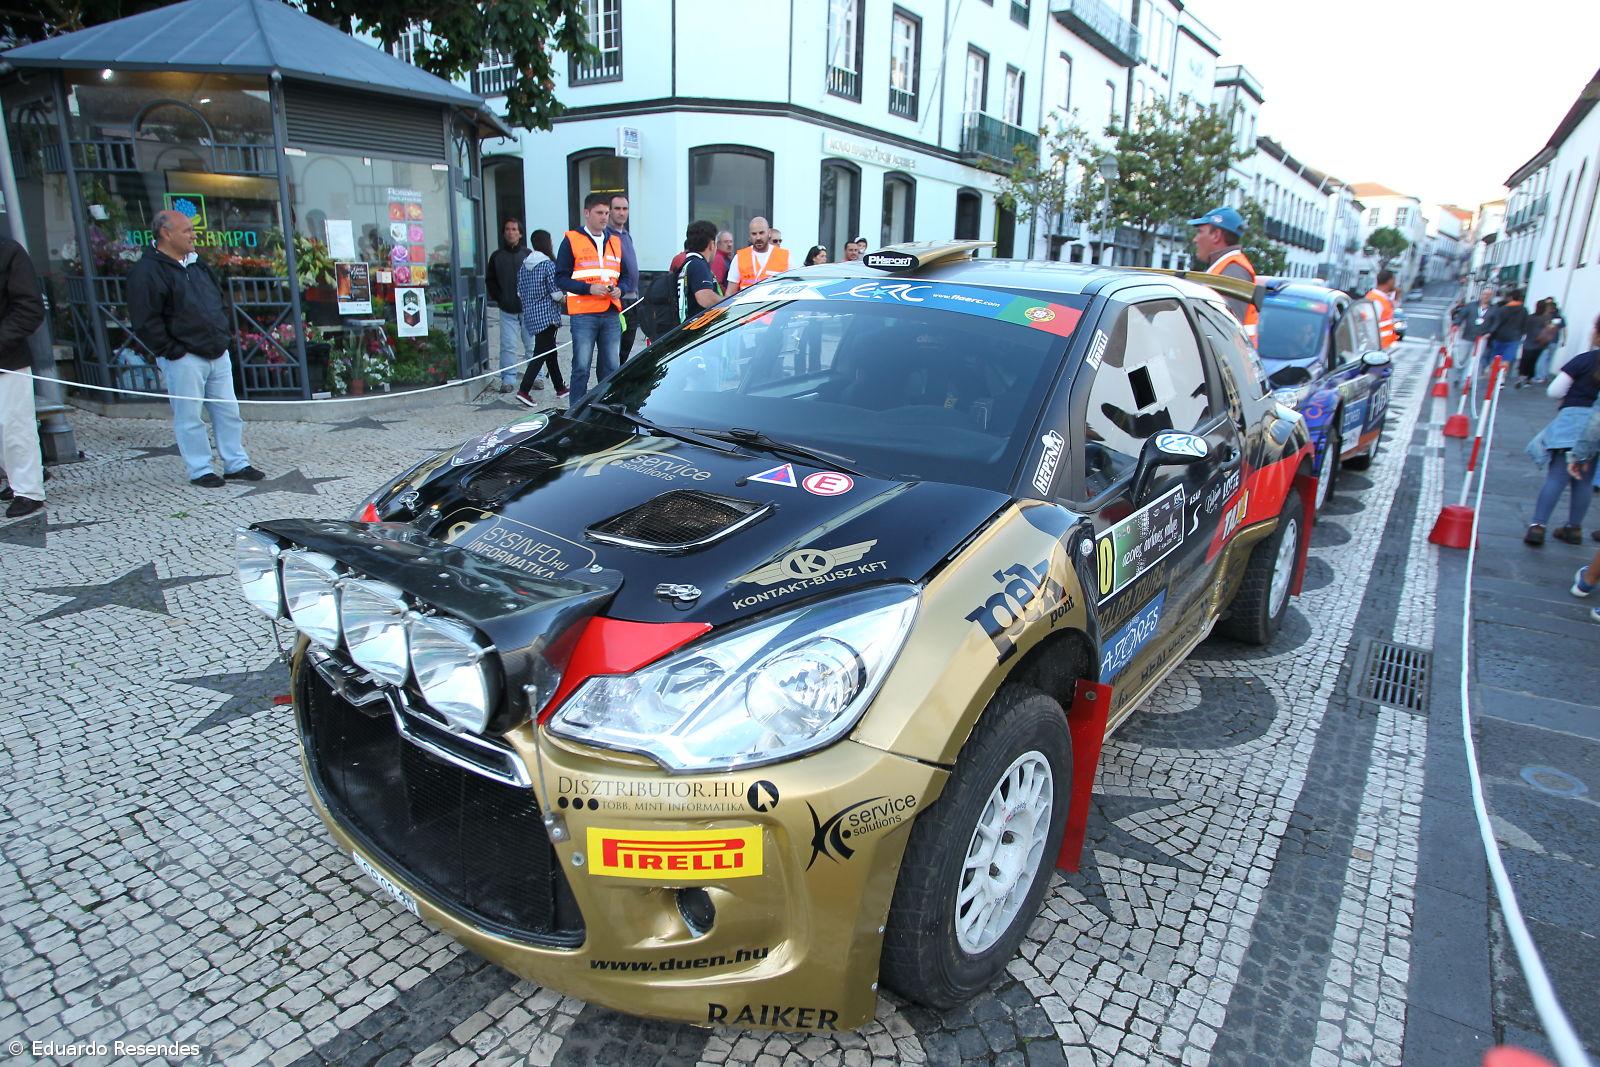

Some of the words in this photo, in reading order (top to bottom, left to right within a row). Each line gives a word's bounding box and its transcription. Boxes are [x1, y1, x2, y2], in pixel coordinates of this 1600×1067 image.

[1086, 328, 1109, 371] PIRELLI
[619, 460, 676, 481] solutions
[629, 454, 712, 481] service
[814, 475, 843, 492] E
[468, 540, 556, 579] INFORMATIKA
[483, 527, 570, 571] SYSINFO.HU
[732, 567, 858, 610] KONTAKT-BUSZ
[858, 560, 887, 574] KFT
[1099, 605, 1159, 677] AZORES
[634, 802, 664, 812] MINT
[668, 802, 745, 812] INFORMATIKA
[848, 793, 917, 827] service
[852, 813, 902, 837] solutions
[602, 838, 746, 871] PIRELLI
[590, 946, 769, 973] www.duen.hu
[707, 1002, 840, 1031] RAIKER
